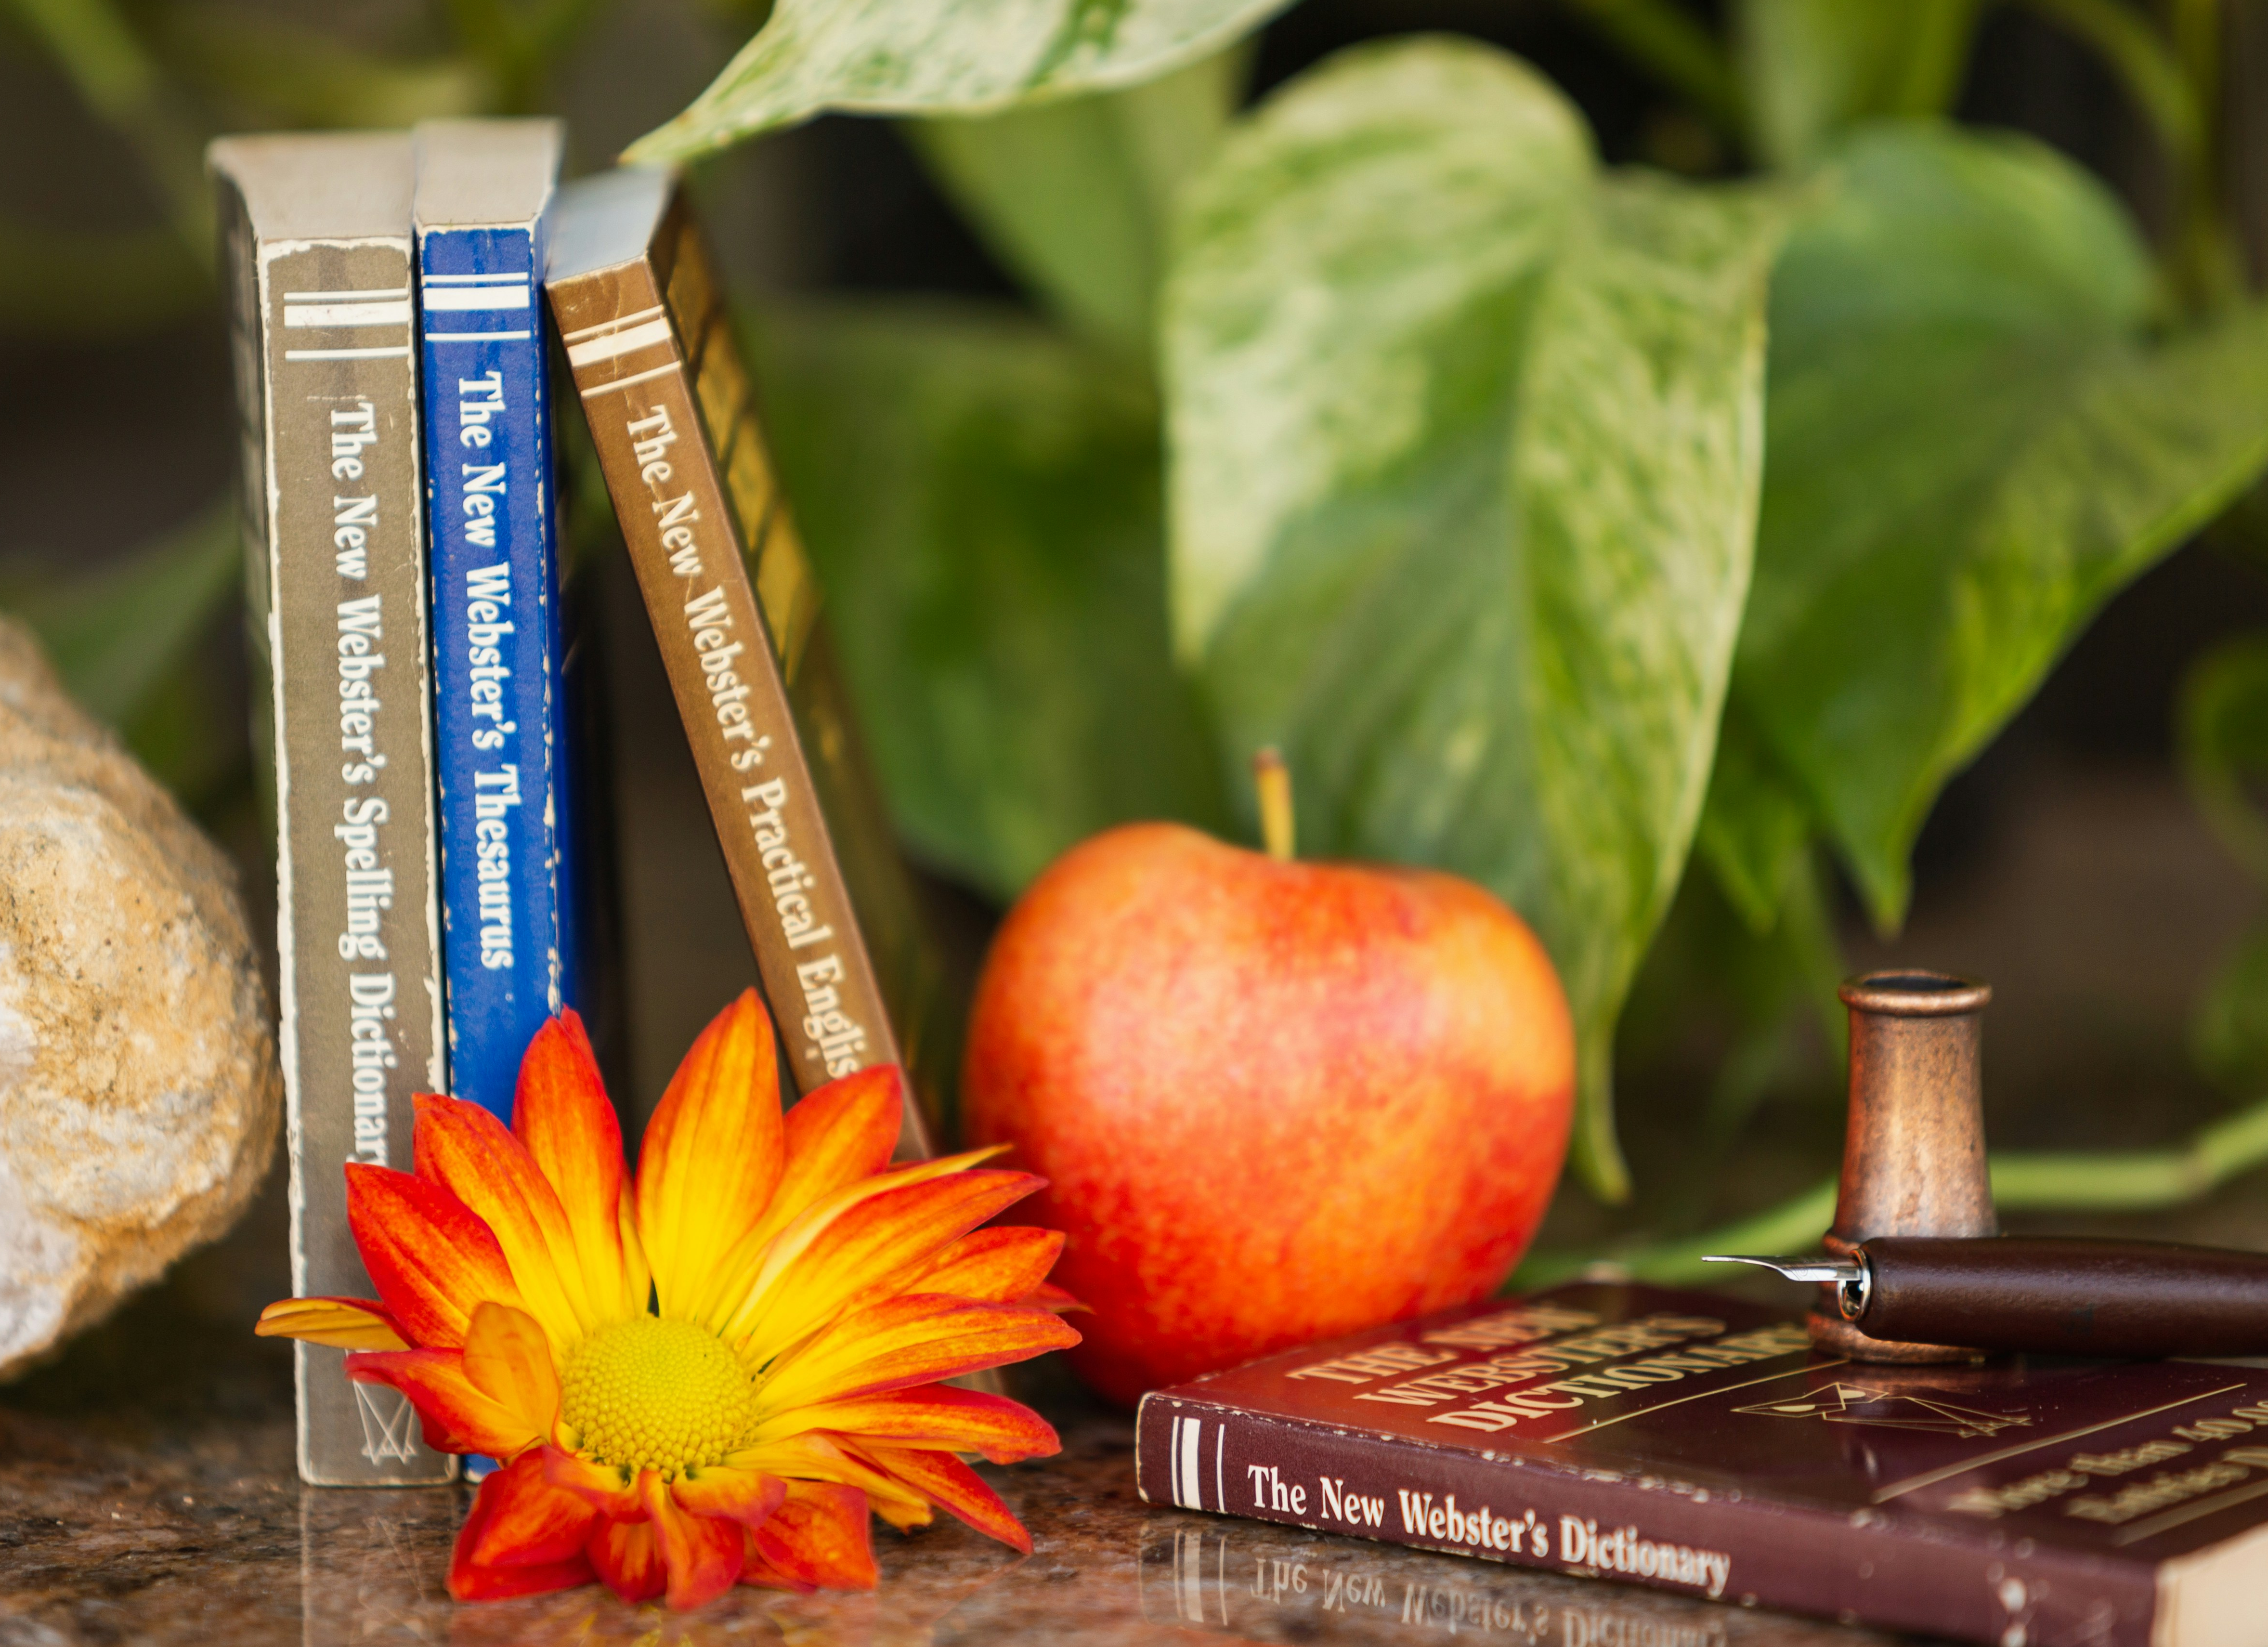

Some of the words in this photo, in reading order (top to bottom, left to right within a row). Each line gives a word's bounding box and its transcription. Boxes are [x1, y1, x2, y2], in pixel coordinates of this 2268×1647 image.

[330, 402, 378, 480] The
[458, 370, 507, 448] The
[333, 494, 378, 579] New
[461, 461, 506, 547] New
[337, 593, 386, 784] Webster's
[466, 561, 516, 750] Webster's
[626, 404, 678, 484] The
[652, 490, 702, 575] New
[684, 585, 771, 771] Webster's
[741, 776, 833, 949] Practical
[796, 954, 866, 1078] Englis
[333, 797, 393, 961] Spelling
[473, 763, 522, 970] Thesaurus
[1285, 1342, 1458, 1385] THE
[1247, 1464, 1307, 1516] The
[1319, 1477, 1384, 1528] New
[1398, 1490, 1549, 1557] Webster's
[1560, 1516, 1730, 1596] Dictionary
